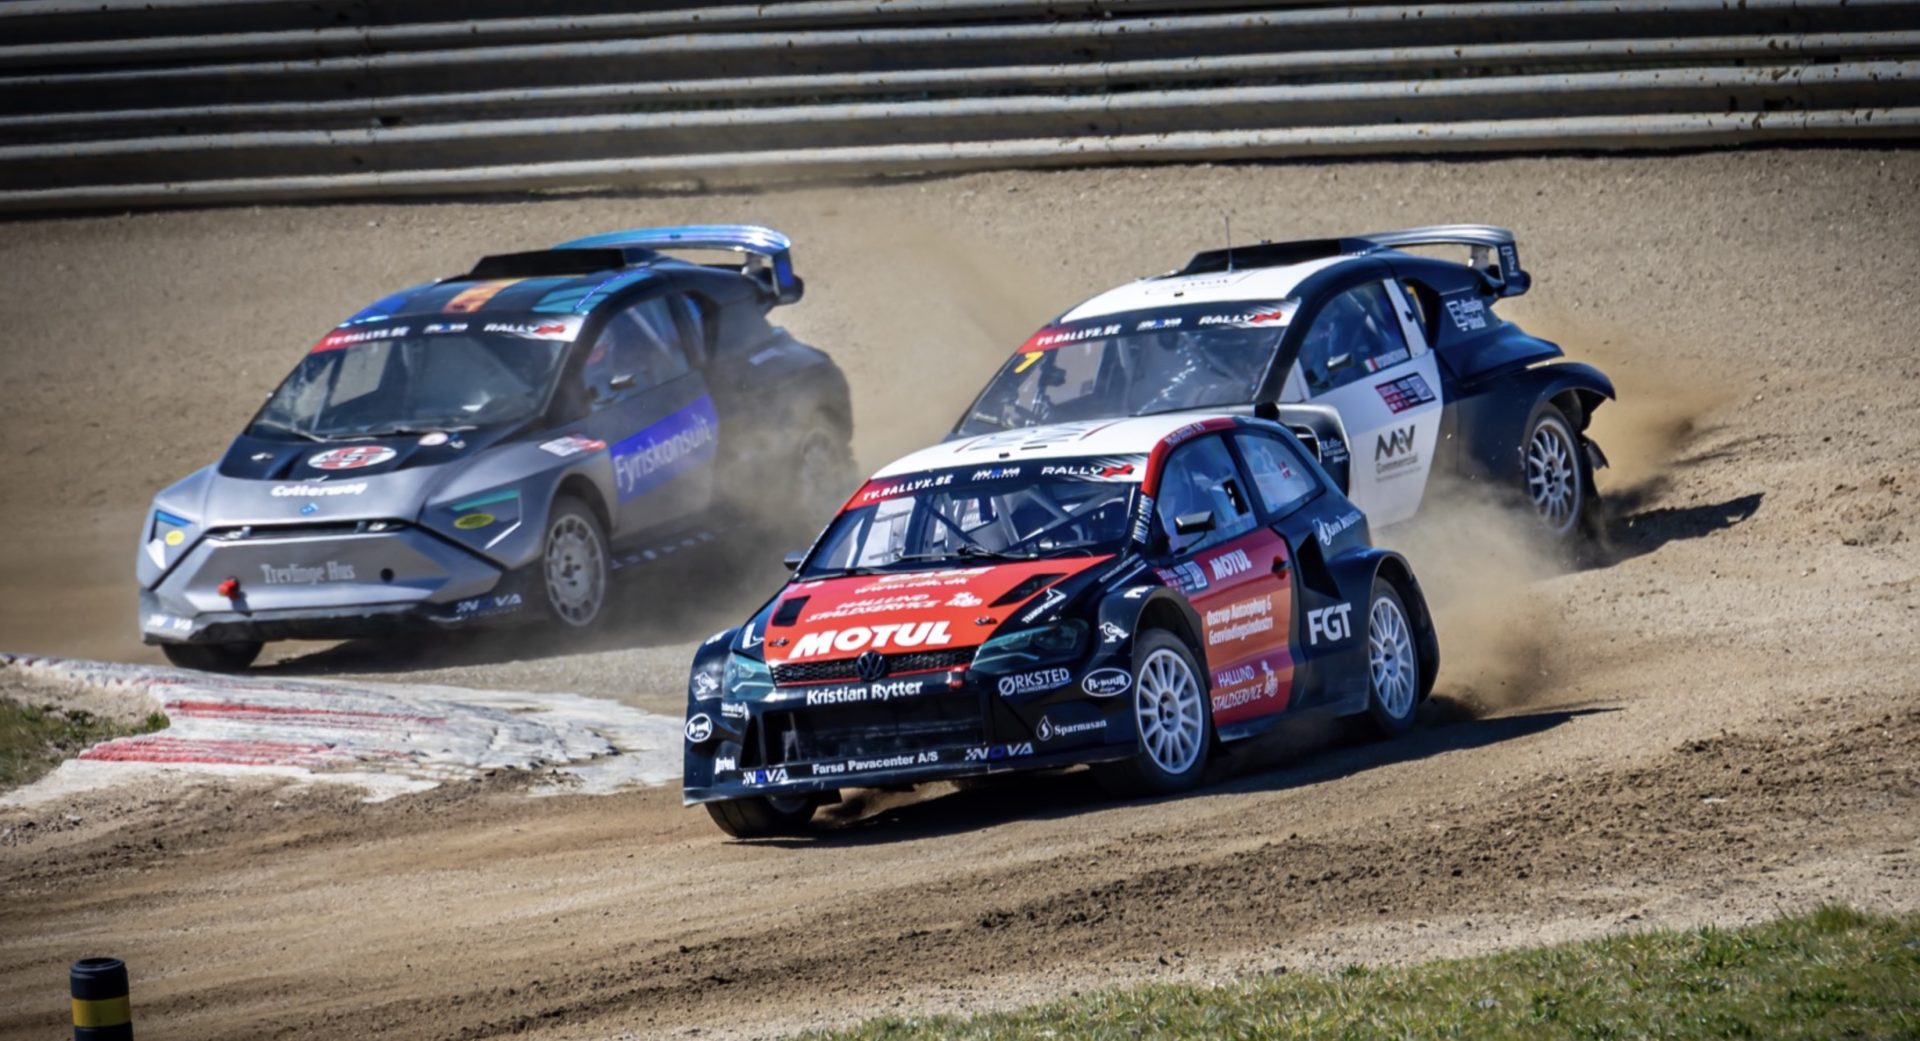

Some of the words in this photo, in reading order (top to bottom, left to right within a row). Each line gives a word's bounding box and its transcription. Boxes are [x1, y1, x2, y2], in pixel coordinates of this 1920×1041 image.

[1014, 351, 1044, 374] 7
[613, 413, 713, 493] Fyriskonsult
[1209, 549, 1252, 580] MOTUL
[1307, 602, 1352, 646] FGT
[788, 620, 952, 660] MOTUL
[998, 667, 1070, 697] ØRKSTED
[1218, 665, 1255, 688] HALLUND
[806, 686, 868, 705] Kristian
[871, 679, 924, 701] Rytter
[1054, 719, 1107, 737] Sparmasan
[812, 763, 845, 776] Farsø
[848, 756, 915, 772] Pavacenter
[917, 751, 940, 764] A/S
[743, 769, 790, 785] NOVA
